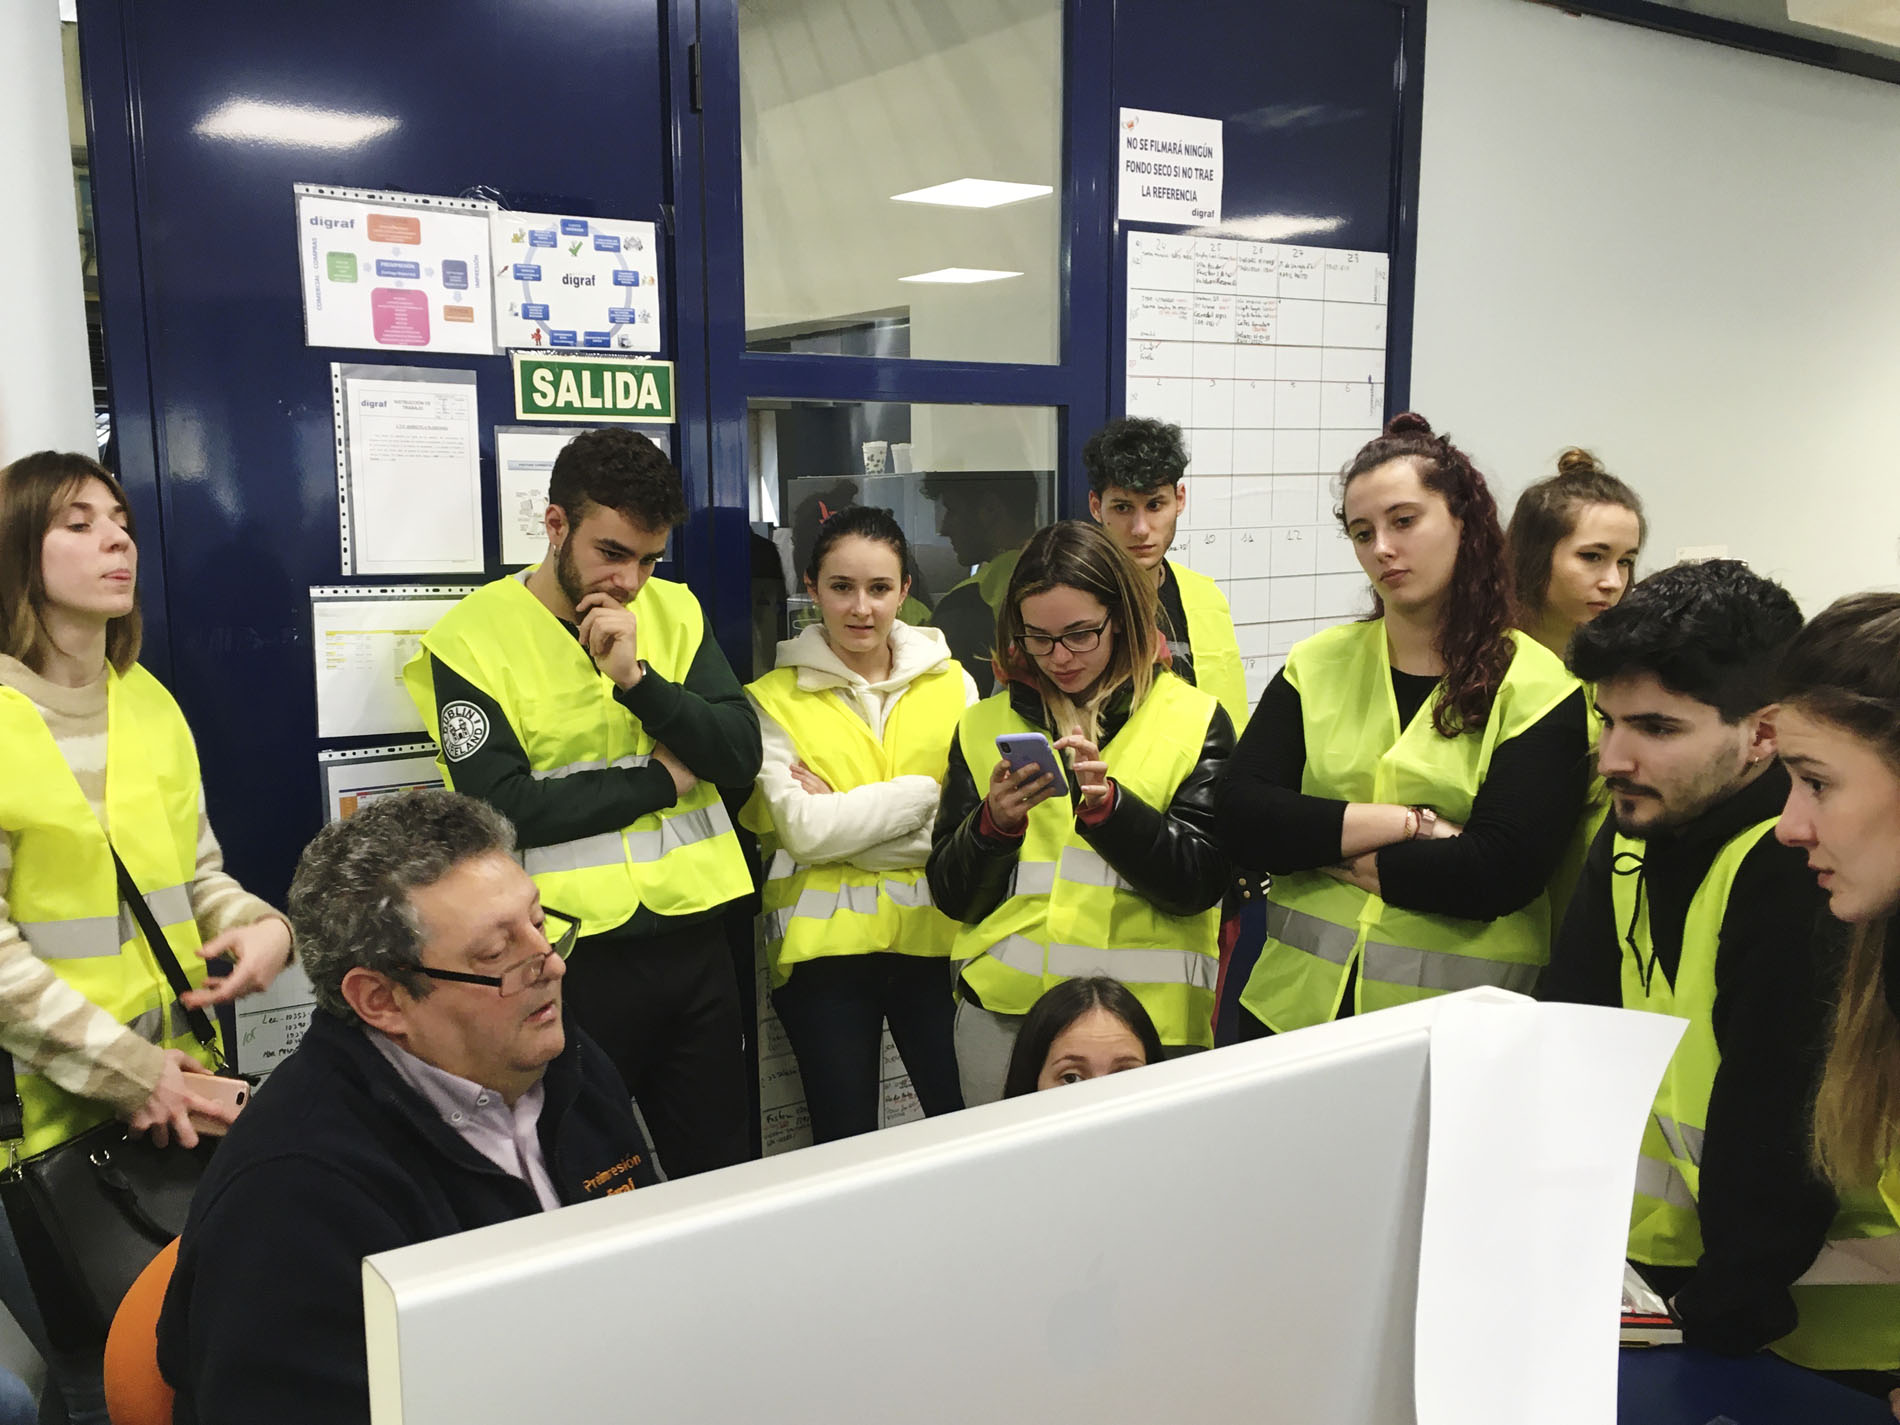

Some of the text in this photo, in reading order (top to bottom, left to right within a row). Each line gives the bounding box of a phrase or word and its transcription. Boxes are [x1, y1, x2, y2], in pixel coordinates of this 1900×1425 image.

[1126, 136, 1213, 158] NO SE FILMARÁ NINGÚN
[1125, 160, 1214, 181] FONDO SECO SI NO TRAE
[1141, 185, 1198, 202] LA REFERENCIA
[1191, 208, 1215, 219] digraf
[309, 216, 355, 229] digraf
[561, 273, 596, 288] digraf
[532, 367, 662, 410] SALIDA
[361, 399, 388, 409] digraf
[443, 707, 475, 734] DUBLIN
